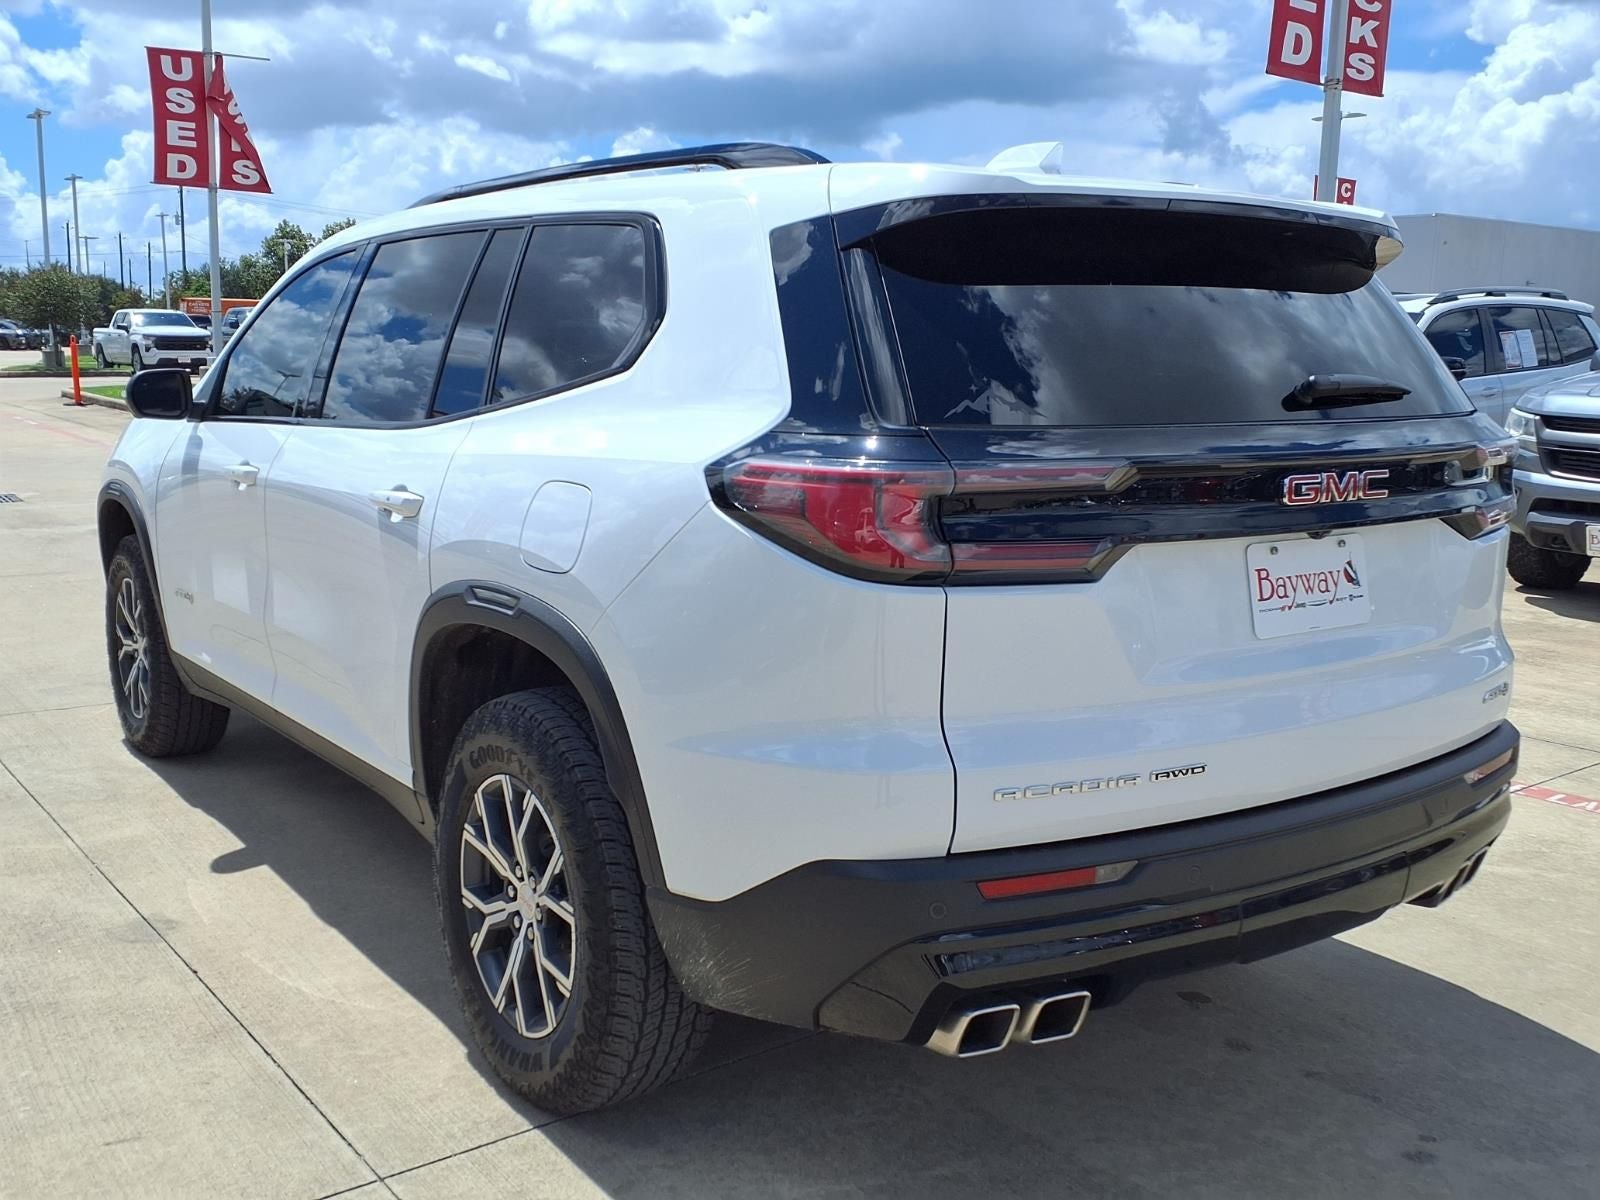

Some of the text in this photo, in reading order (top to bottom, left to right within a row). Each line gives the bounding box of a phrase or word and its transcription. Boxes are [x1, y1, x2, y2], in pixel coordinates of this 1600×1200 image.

[160, 54, 198, 179] USED
[1284, 469, 1390, 506] GMC
[1254, 567, 1341, 611] Bayway
[993, 763, 1207, 801] ACADIA AWD
